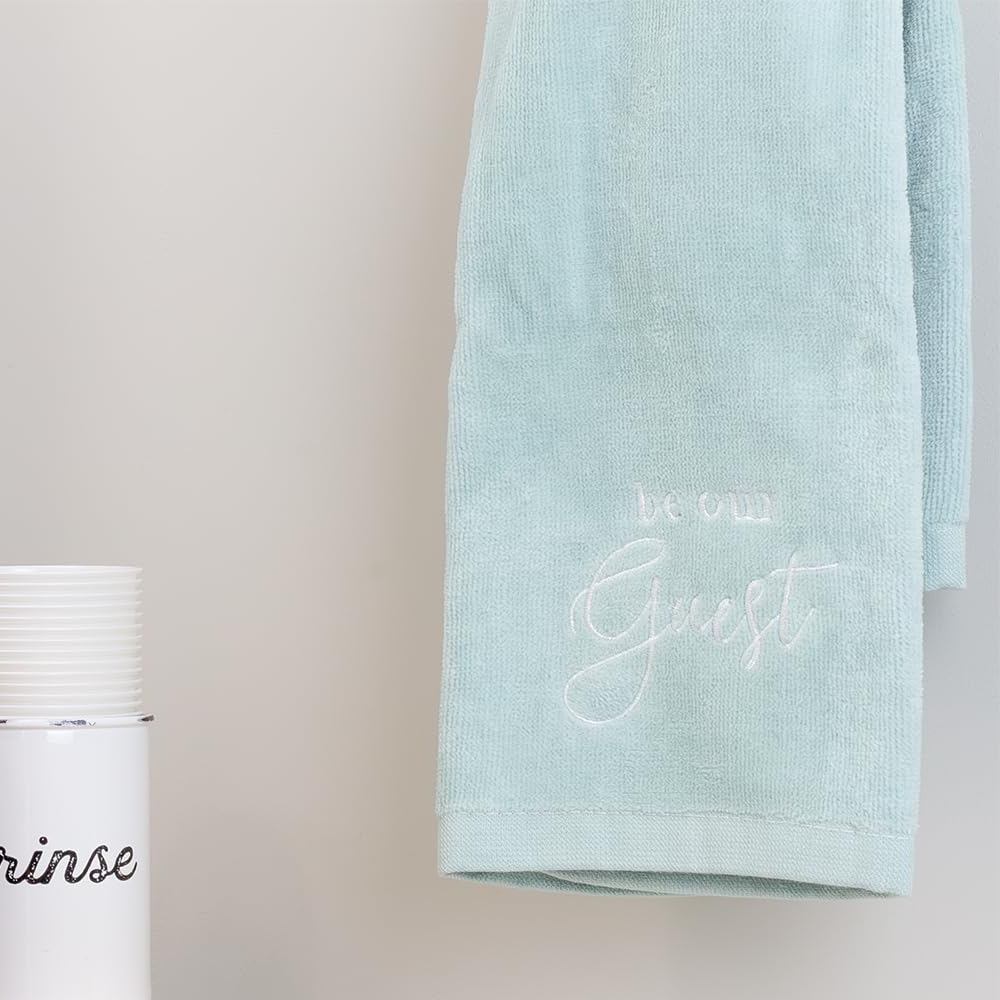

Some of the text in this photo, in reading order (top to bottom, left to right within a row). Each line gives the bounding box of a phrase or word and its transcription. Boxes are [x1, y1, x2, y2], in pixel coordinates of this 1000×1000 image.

[632, 482, 773, 523] be our
[564, 536, 840, 725] Guest
